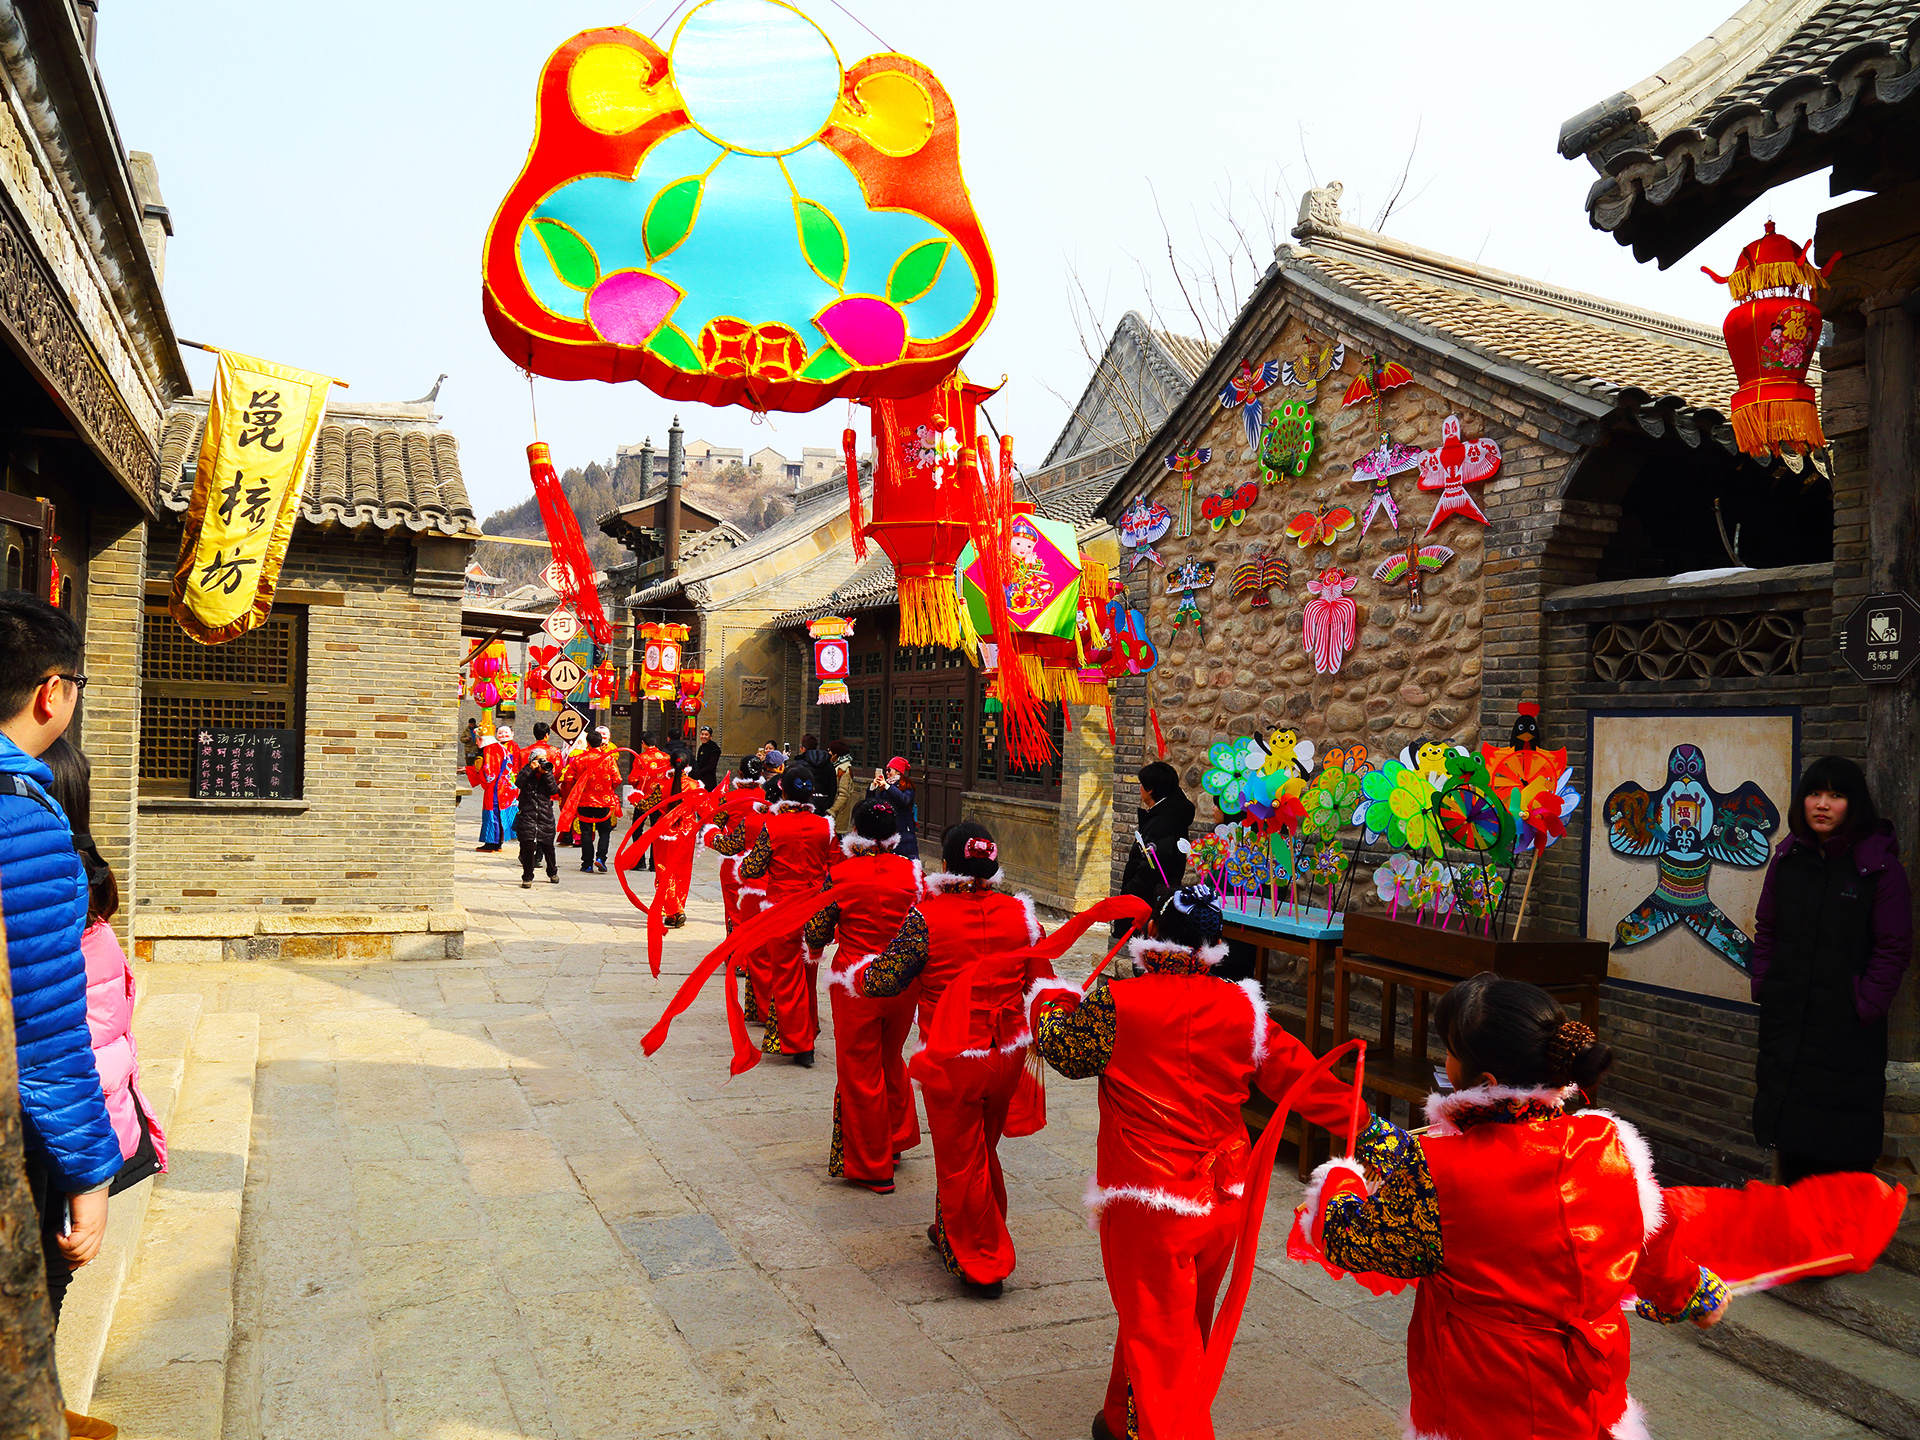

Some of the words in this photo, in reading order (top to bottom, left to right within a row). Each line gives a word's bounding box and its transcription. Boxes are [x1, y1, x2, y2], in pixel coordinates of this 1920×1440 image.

[1782, 311, 1807, 340] 福
[1867, 650, 1899, 662] 风筝铺
[1872, 663, 1892, 671] Shop
[1677, 806, 1691, 818] 福
